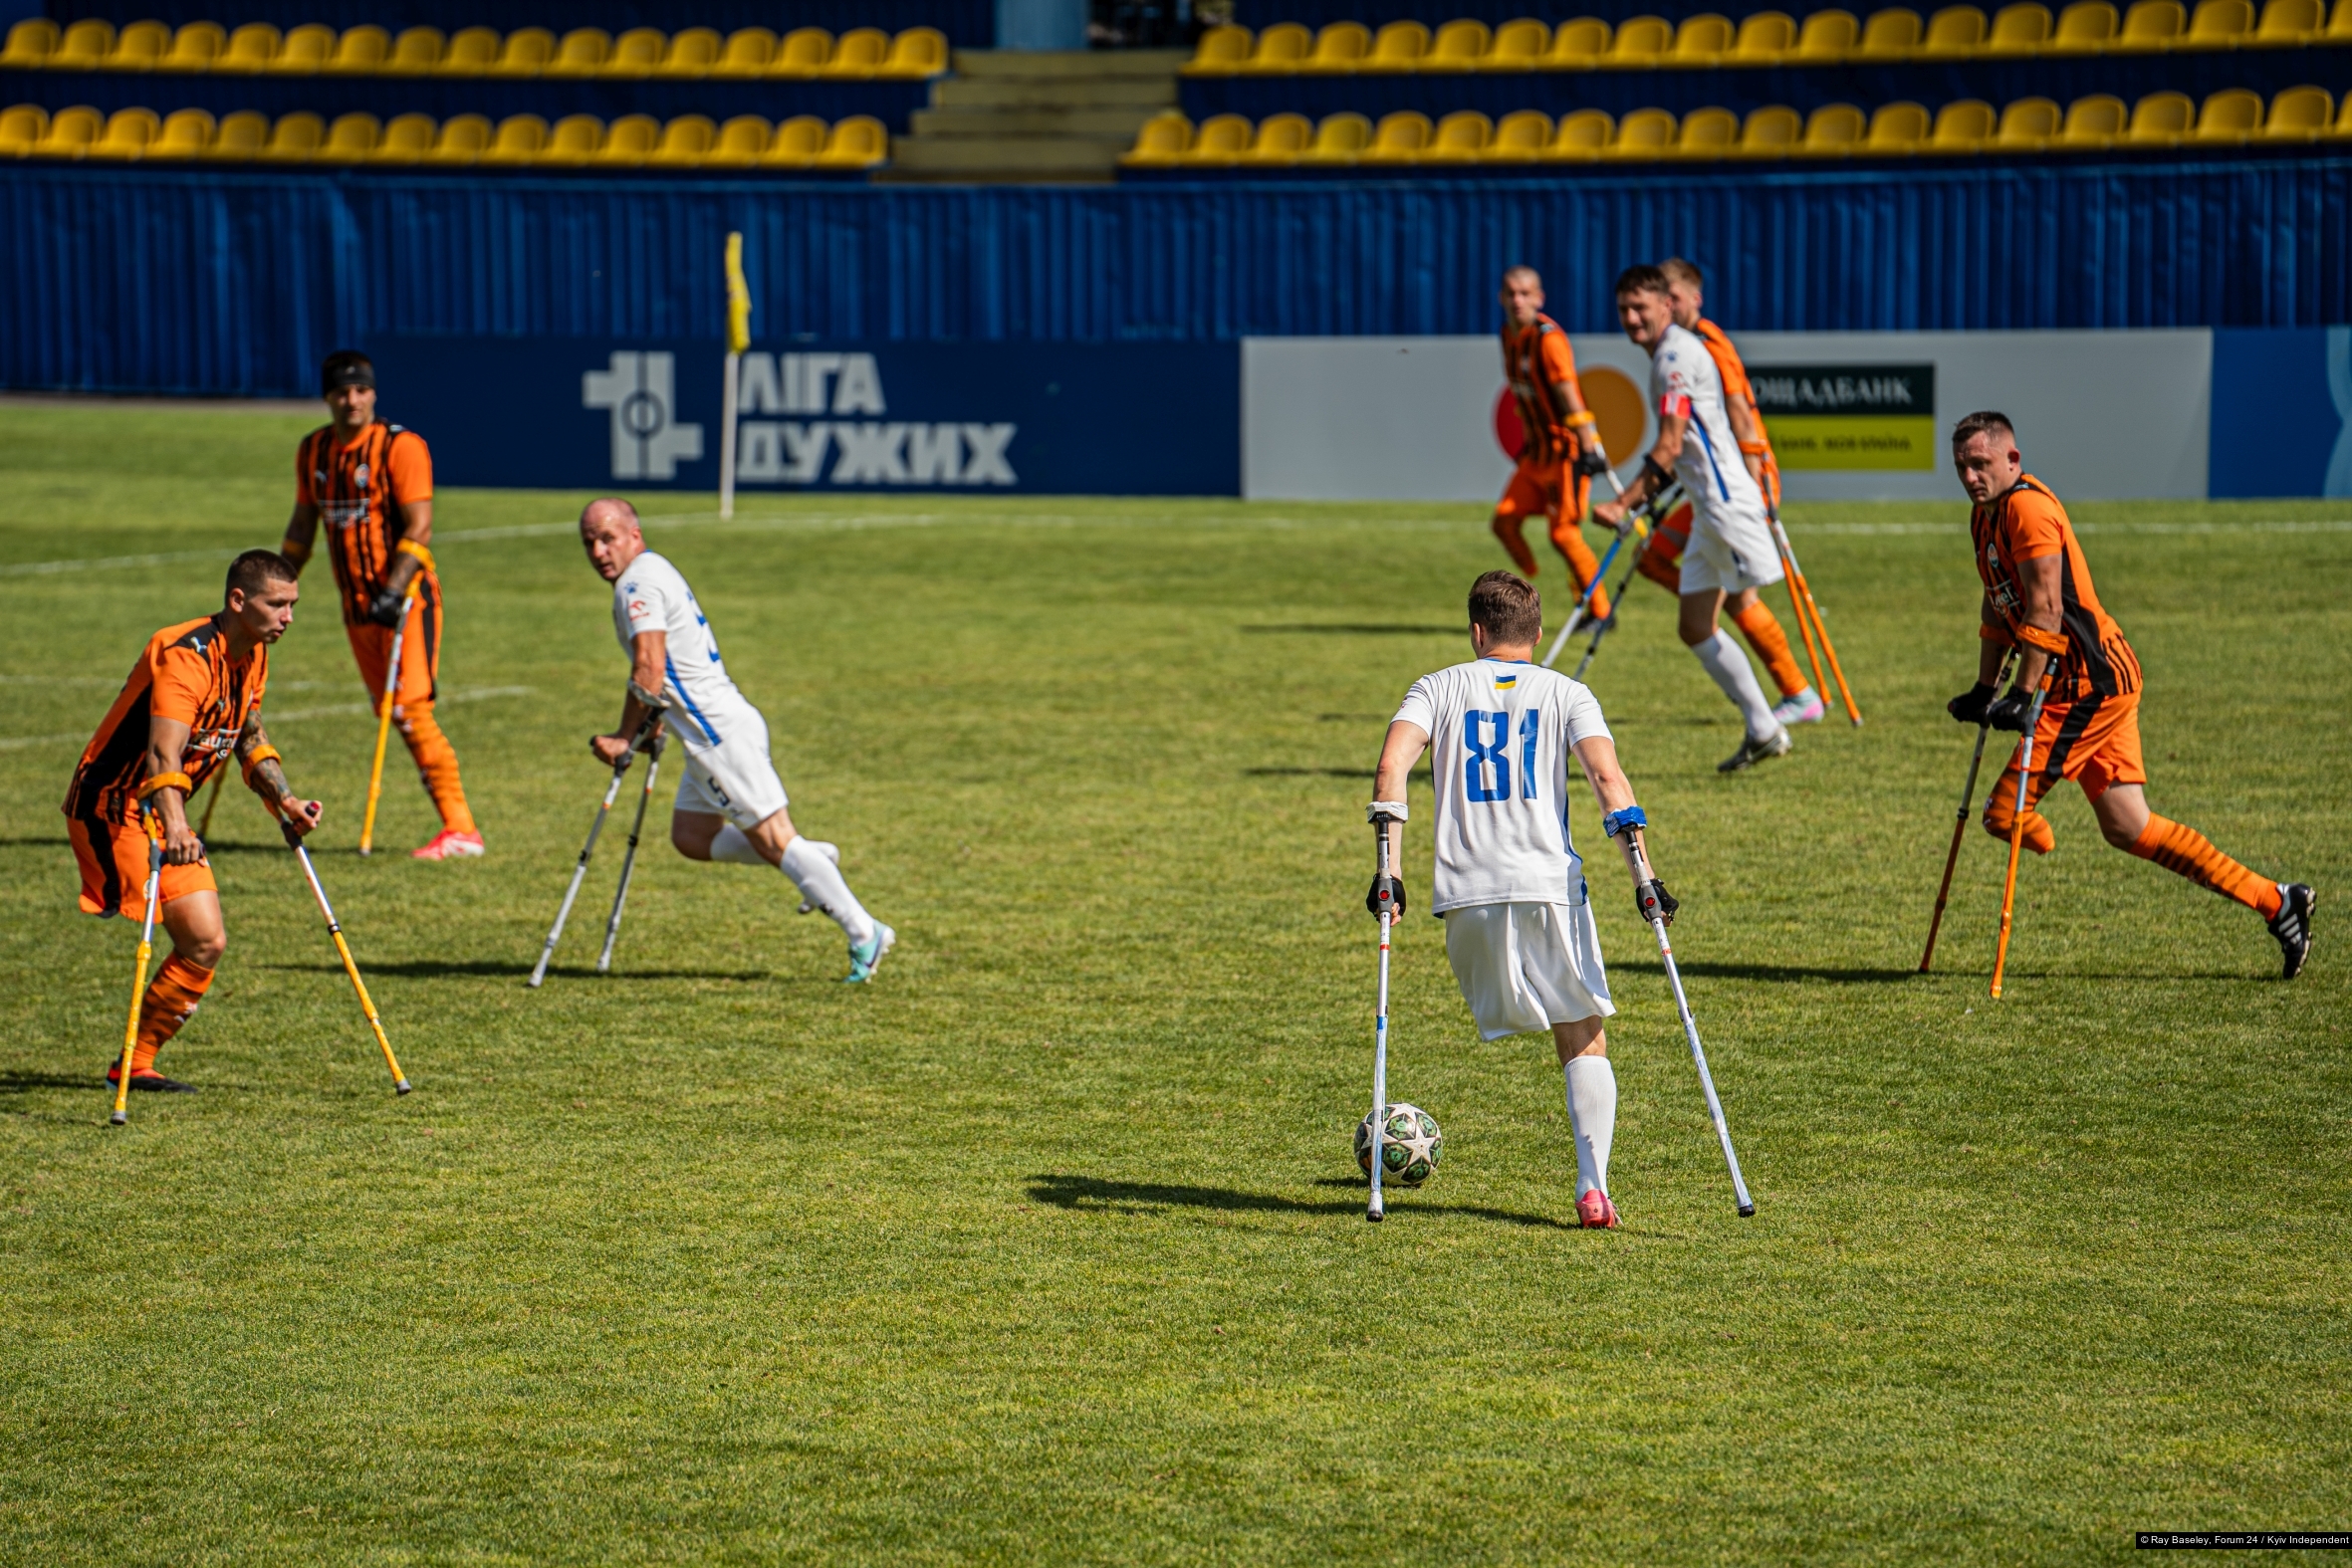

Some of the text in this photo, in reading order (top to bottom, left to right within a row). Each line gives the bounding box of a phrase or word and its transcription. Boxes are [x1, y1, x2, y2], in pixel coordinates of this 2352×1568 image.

[739, 351, 886, 415] ЛІГА
[737, 422, 1019, 484] ДУЖИХ
[1464, 708, 1539, 802] 81
